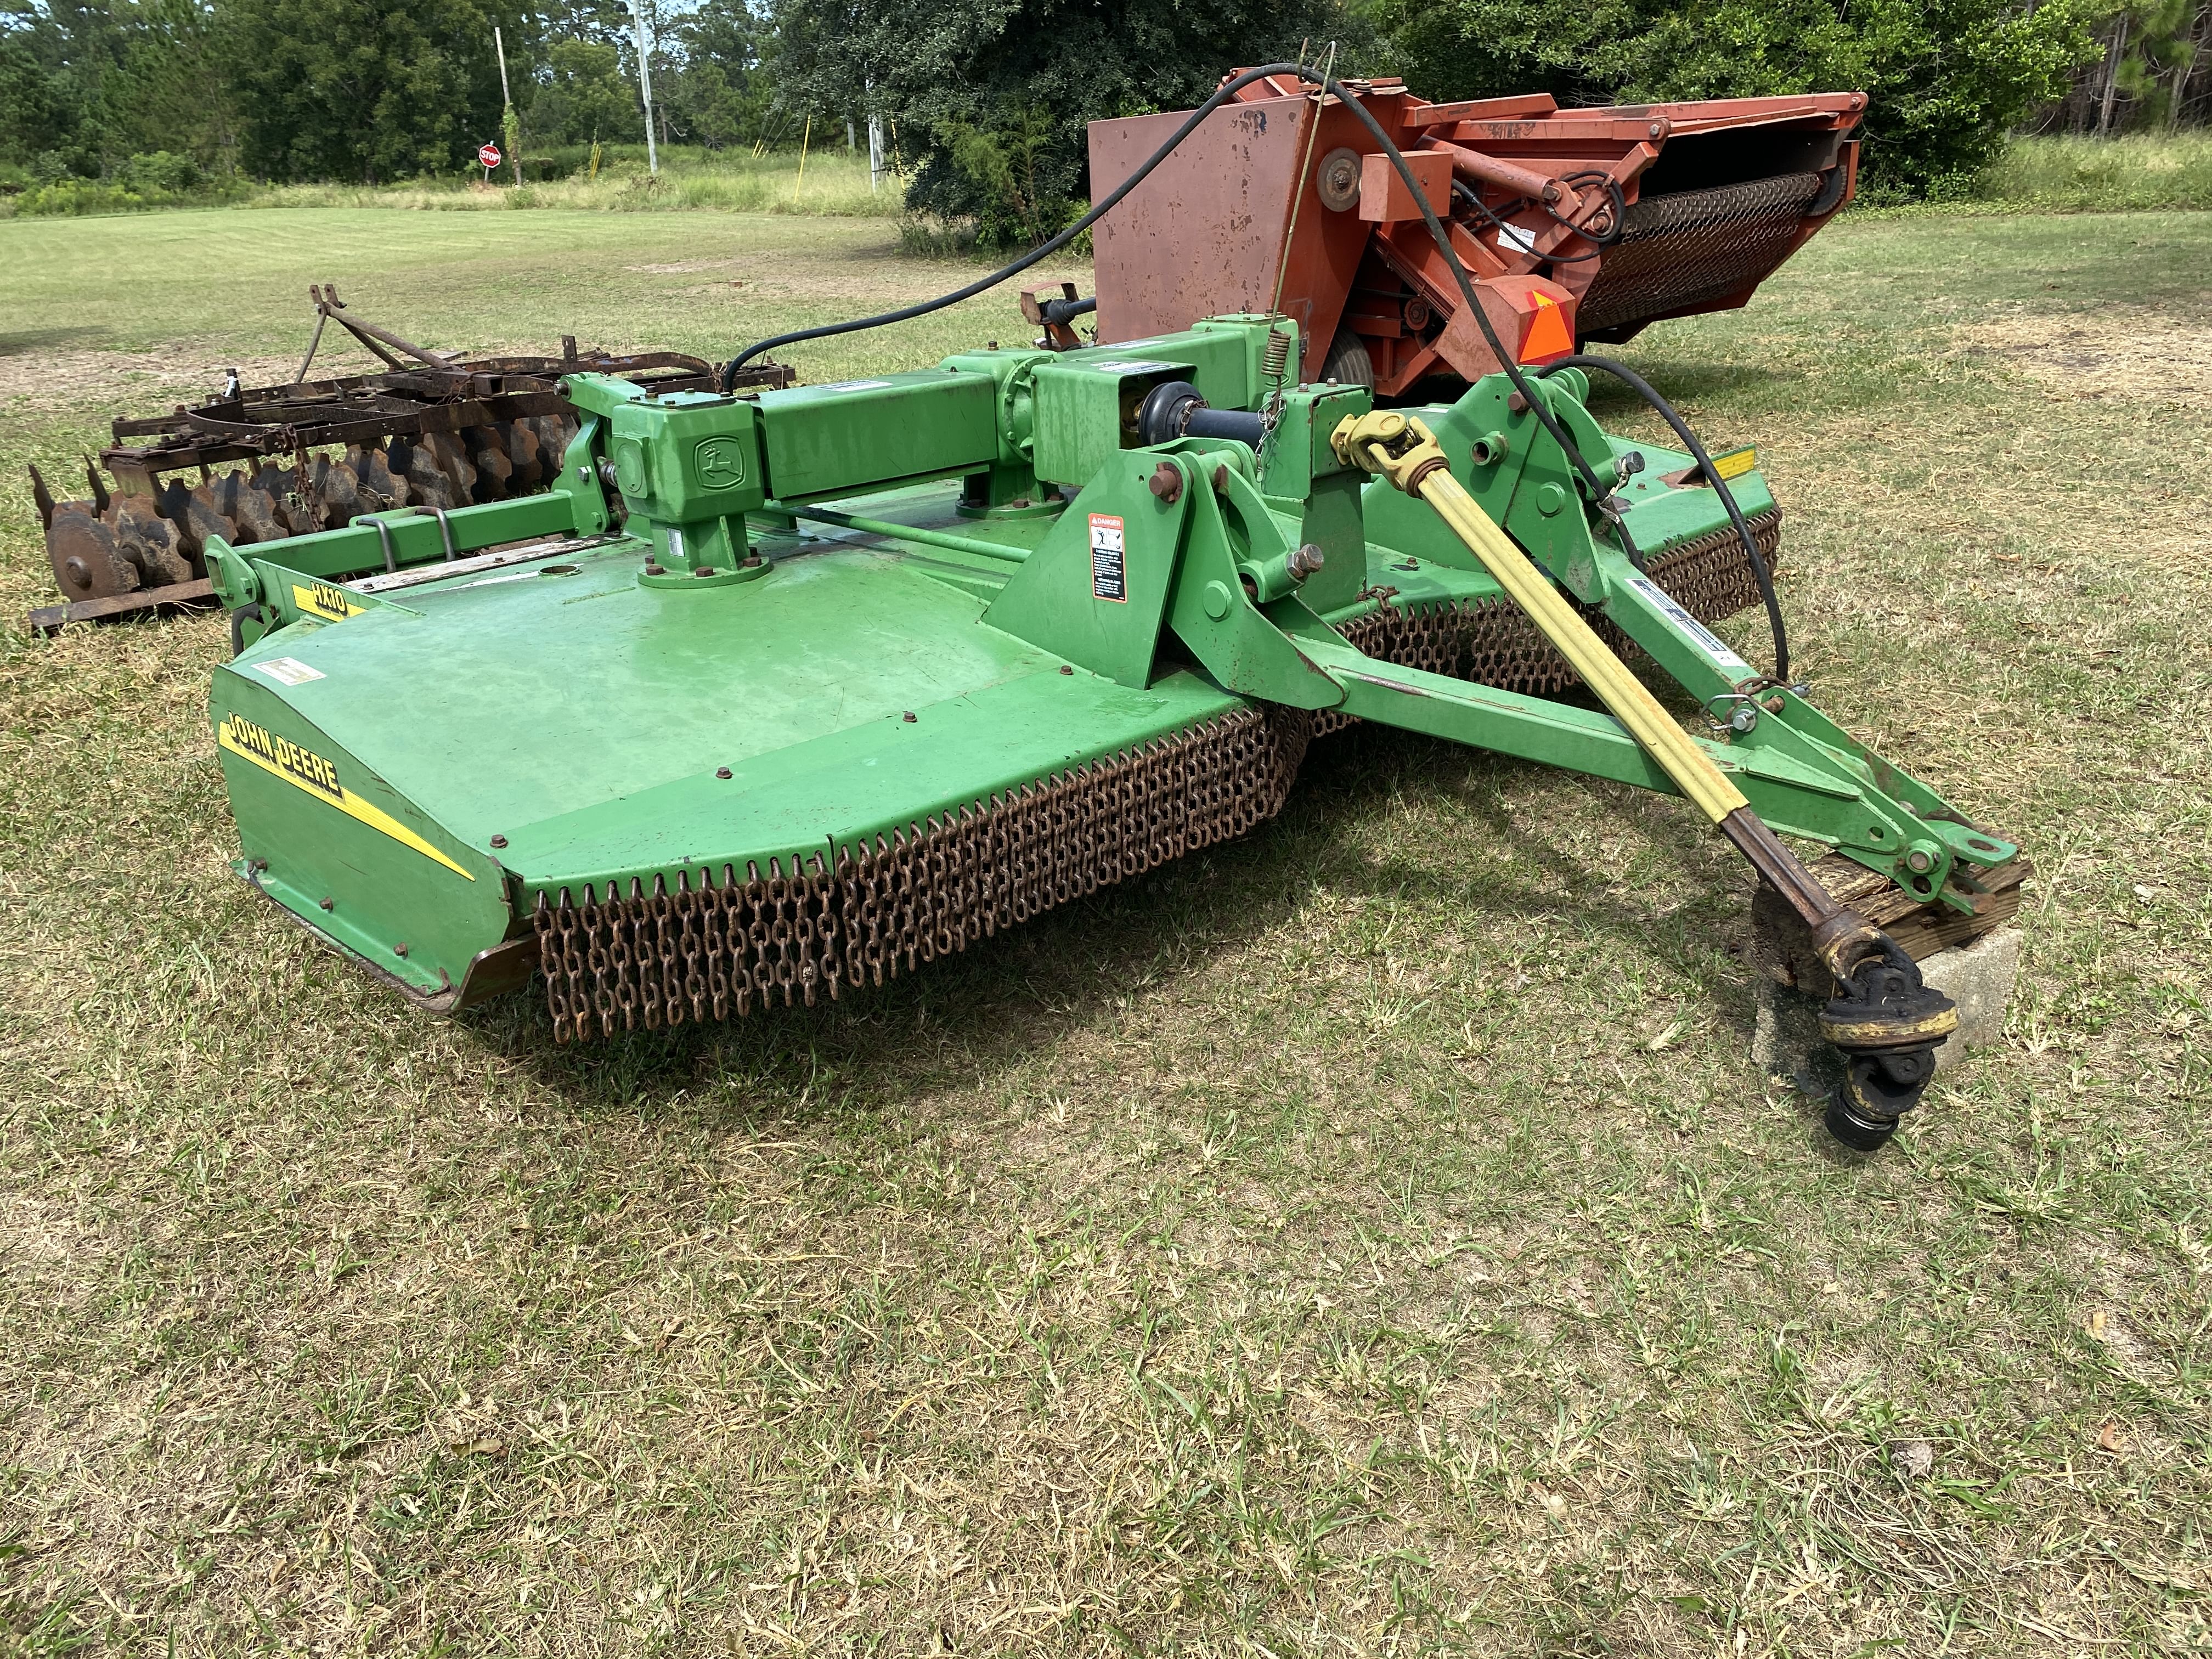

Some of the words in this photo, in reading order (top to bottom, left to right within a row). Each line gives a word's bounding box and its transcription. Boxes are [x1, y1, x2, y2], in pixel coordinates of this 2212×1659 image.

[481, 150, 499, 161] STOP
[1097, 518, 1120, 527] DANGER
[311, 582, 347, 615] HX10
[228, 711, 276, 763] JOHN
[275, 733, 342, 798] DEERE
